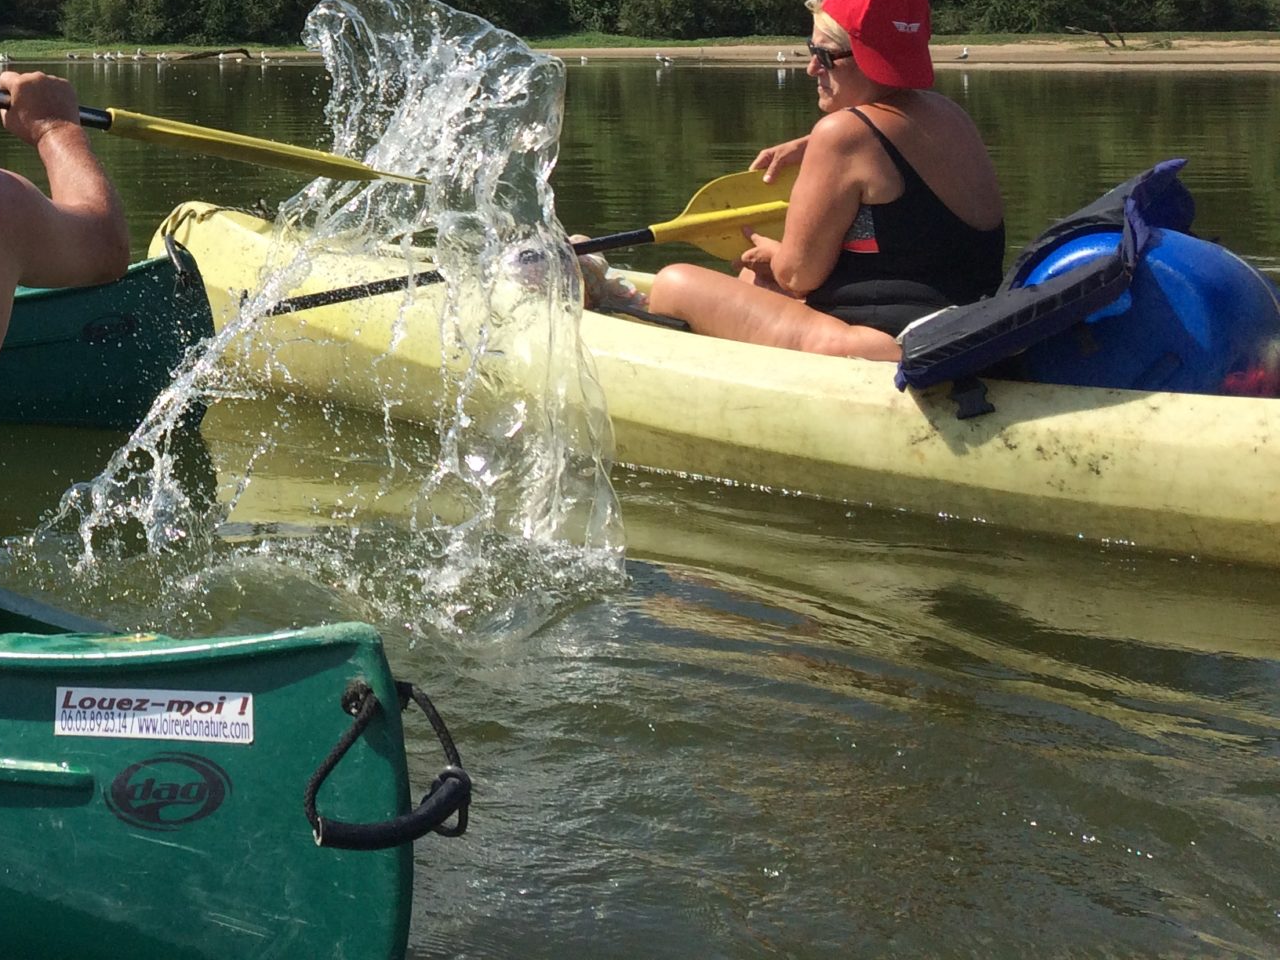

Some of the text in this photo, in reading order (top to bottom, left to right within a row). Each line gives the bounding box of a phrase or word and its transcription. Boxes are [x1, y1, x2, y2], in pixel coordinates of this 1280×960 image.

[62, 690, 250, 716] Louez-moi !
[138, 712, 250, 739] www.loirevelonature.com
[126, 777, 208, 807] dag
